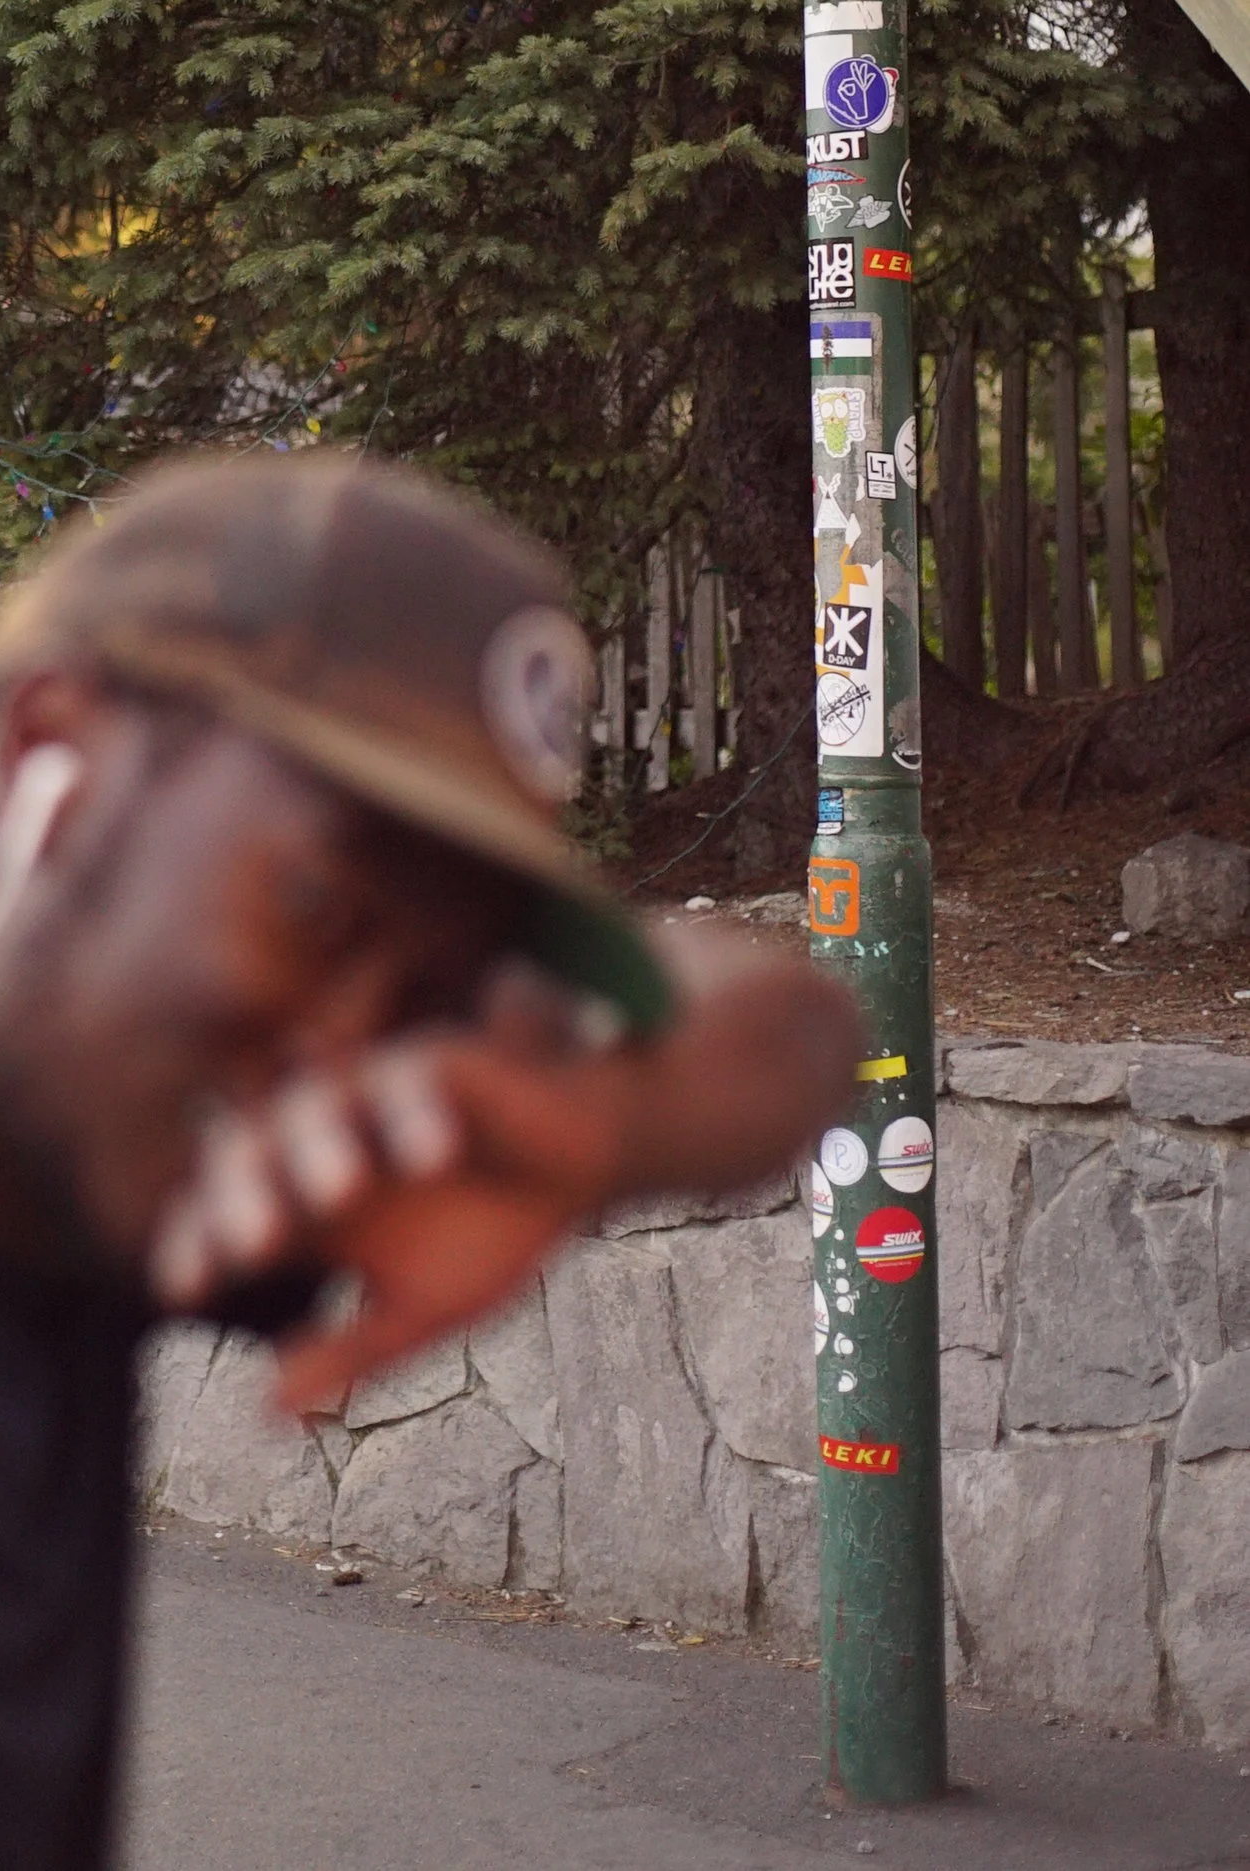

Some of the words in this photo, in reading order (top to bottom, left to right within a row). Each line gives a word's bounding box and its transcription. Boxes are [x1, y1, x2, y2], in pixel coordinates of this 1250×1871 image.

[806, 130, 866, 166] KUST
[869, 253, 913, 274] LEK
[827, 654, 856, 667] D-DAY
[821, 1440, 892, 1466] LEKI
